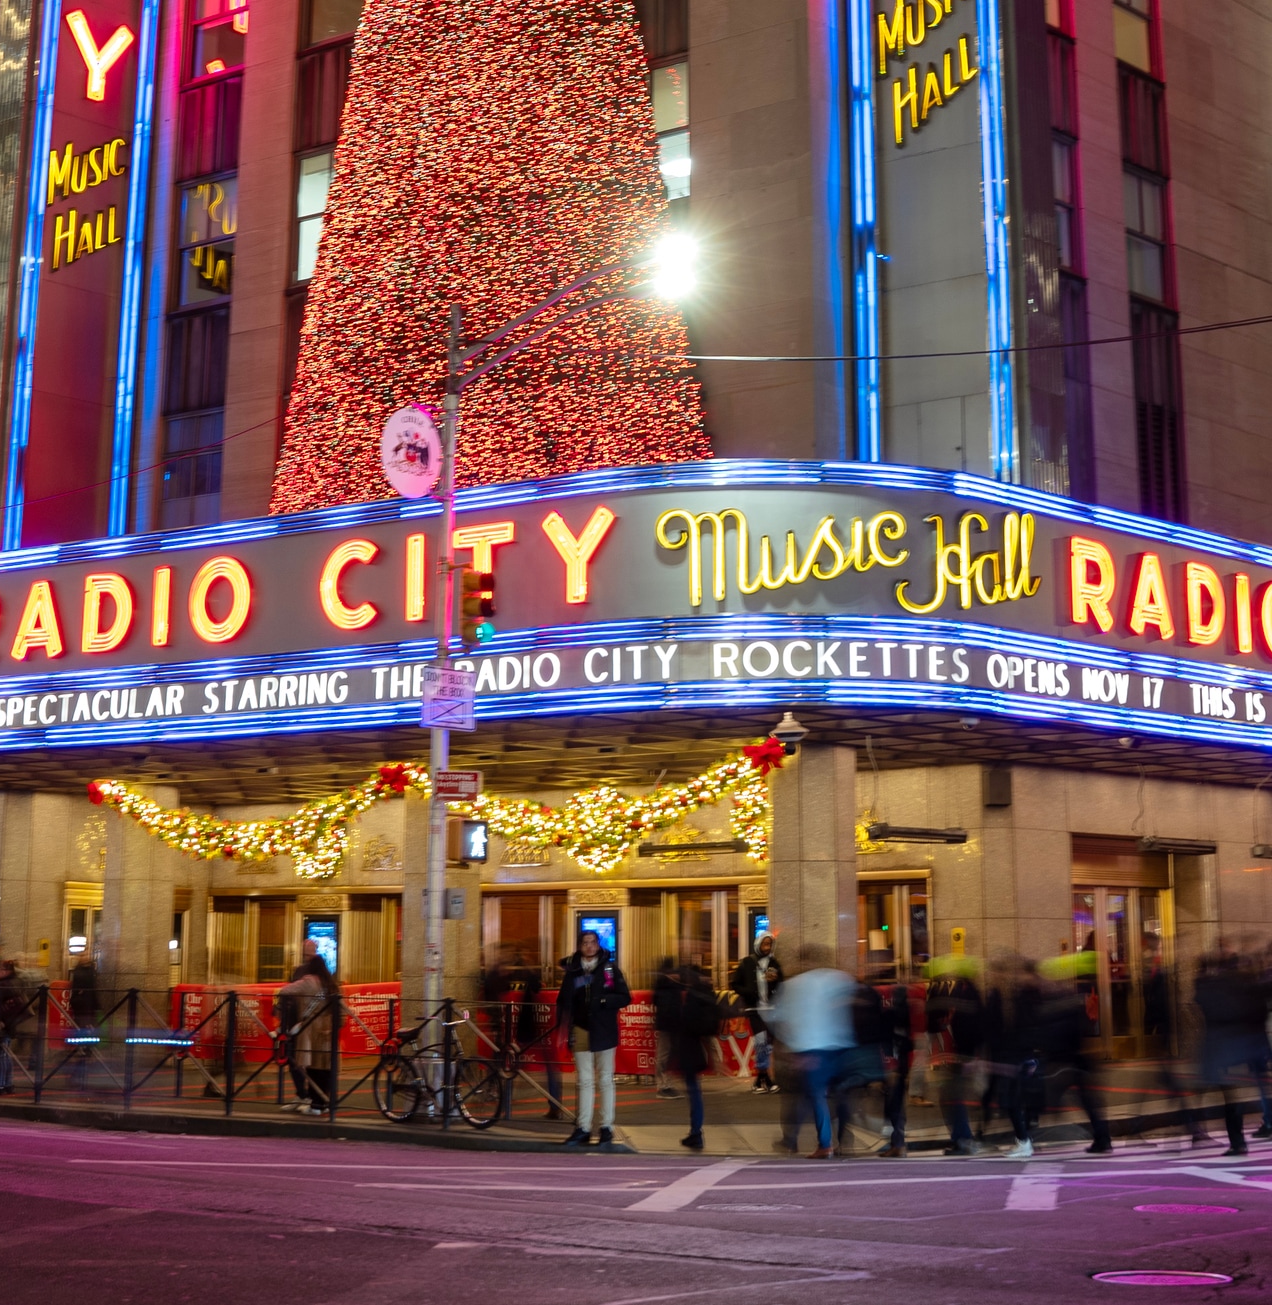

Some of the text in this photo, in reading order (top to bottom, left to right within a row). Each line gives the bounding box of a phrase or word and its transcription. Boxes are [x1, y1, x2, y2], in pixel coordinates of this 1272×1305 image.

[892, 33, 978, 144] HALL
[47, 137, 126, 204] MUSIC
[51, 206, 121, 272] HALL
[319, 504, 617, 631] CITY
[655, 507, 910, 607] Music
[894, 510, 1042, 614] Hall
[202, 671, 350, 715] STARRING
[371, 664, 425, 700] THE
[584, 643, 679, 684] CITY
[713, 640, 970, 684] ROCKETTES
[986, 653, 1070, 697] OPENS
[1081, 668, 1129, 704] NOV
[1142, 676, 1164, 709] 17
[1190, 683, 1236, 719] THIS
[1245, 692, 1266, 723] IS
